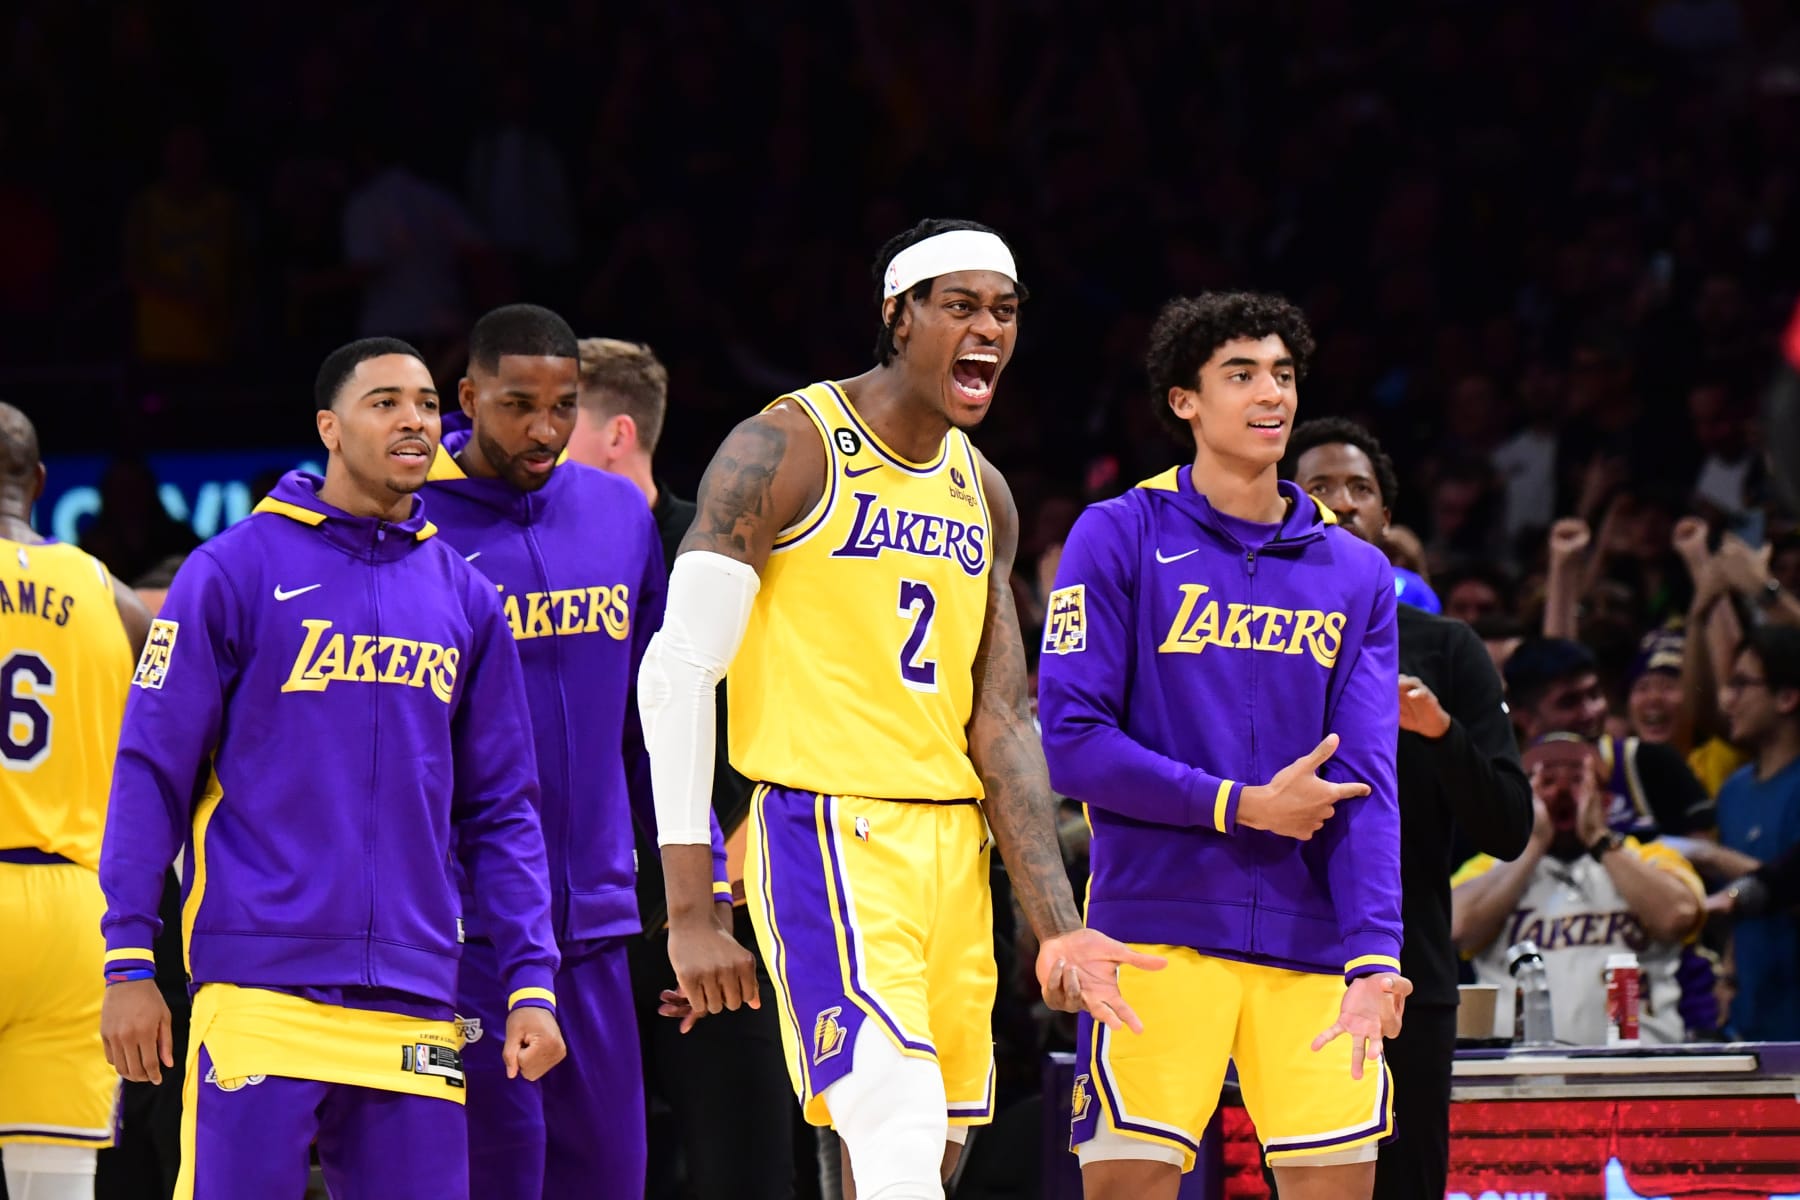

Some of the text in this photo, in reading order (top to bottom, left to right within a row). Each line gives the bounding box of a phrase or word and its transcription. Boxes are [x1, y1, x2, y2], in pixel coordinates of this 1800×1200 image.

[837, 431, 856, 453] 6
[829, 492, 987, 577] LAKERS
[949, 485, 978, 507] bibigo
[496, 583, 630, 641] AKERS
[896, 577, 939, 694] 2
[1052, 610, 1081, 649] 75
[1158, 583, 1348, 669] LAKERS
[281, 618, 460, 704] LAKERS
[0, 649, 56, 773] 6
